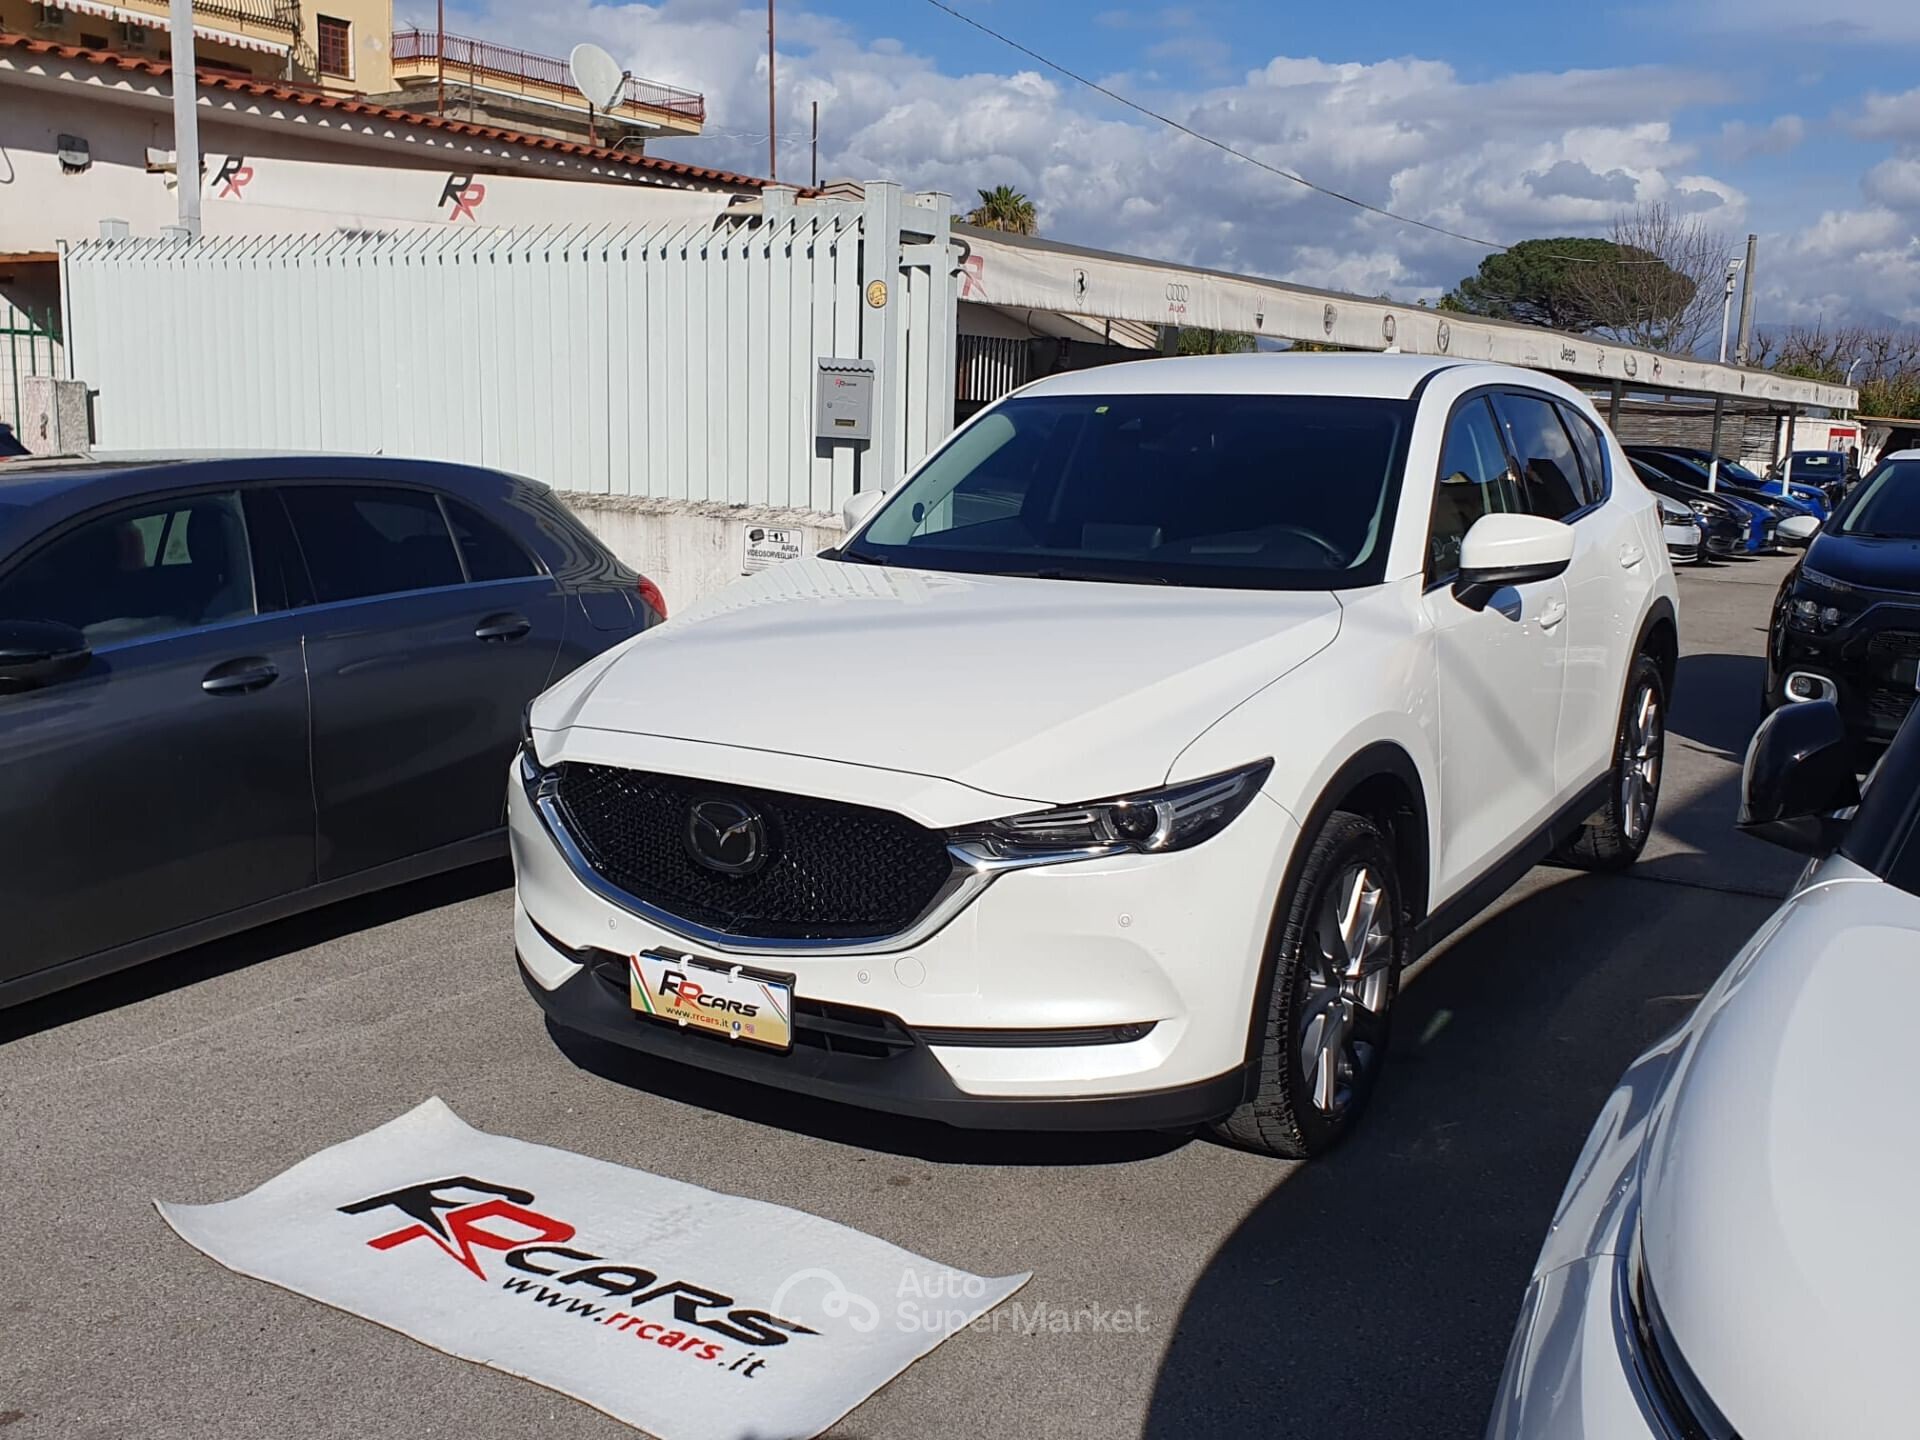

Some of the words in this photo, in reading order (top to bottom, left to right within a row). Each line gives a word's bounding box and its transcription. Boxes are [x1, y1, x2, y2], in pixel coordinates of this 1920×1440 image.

[1560, 343, 1577, 366] Jeep
[780, 544, 799, 552] AREA
[665, 1006, 728, 1028] www.rrcars.it
[502, 1275, 768, 1378] www.rrcars.it
